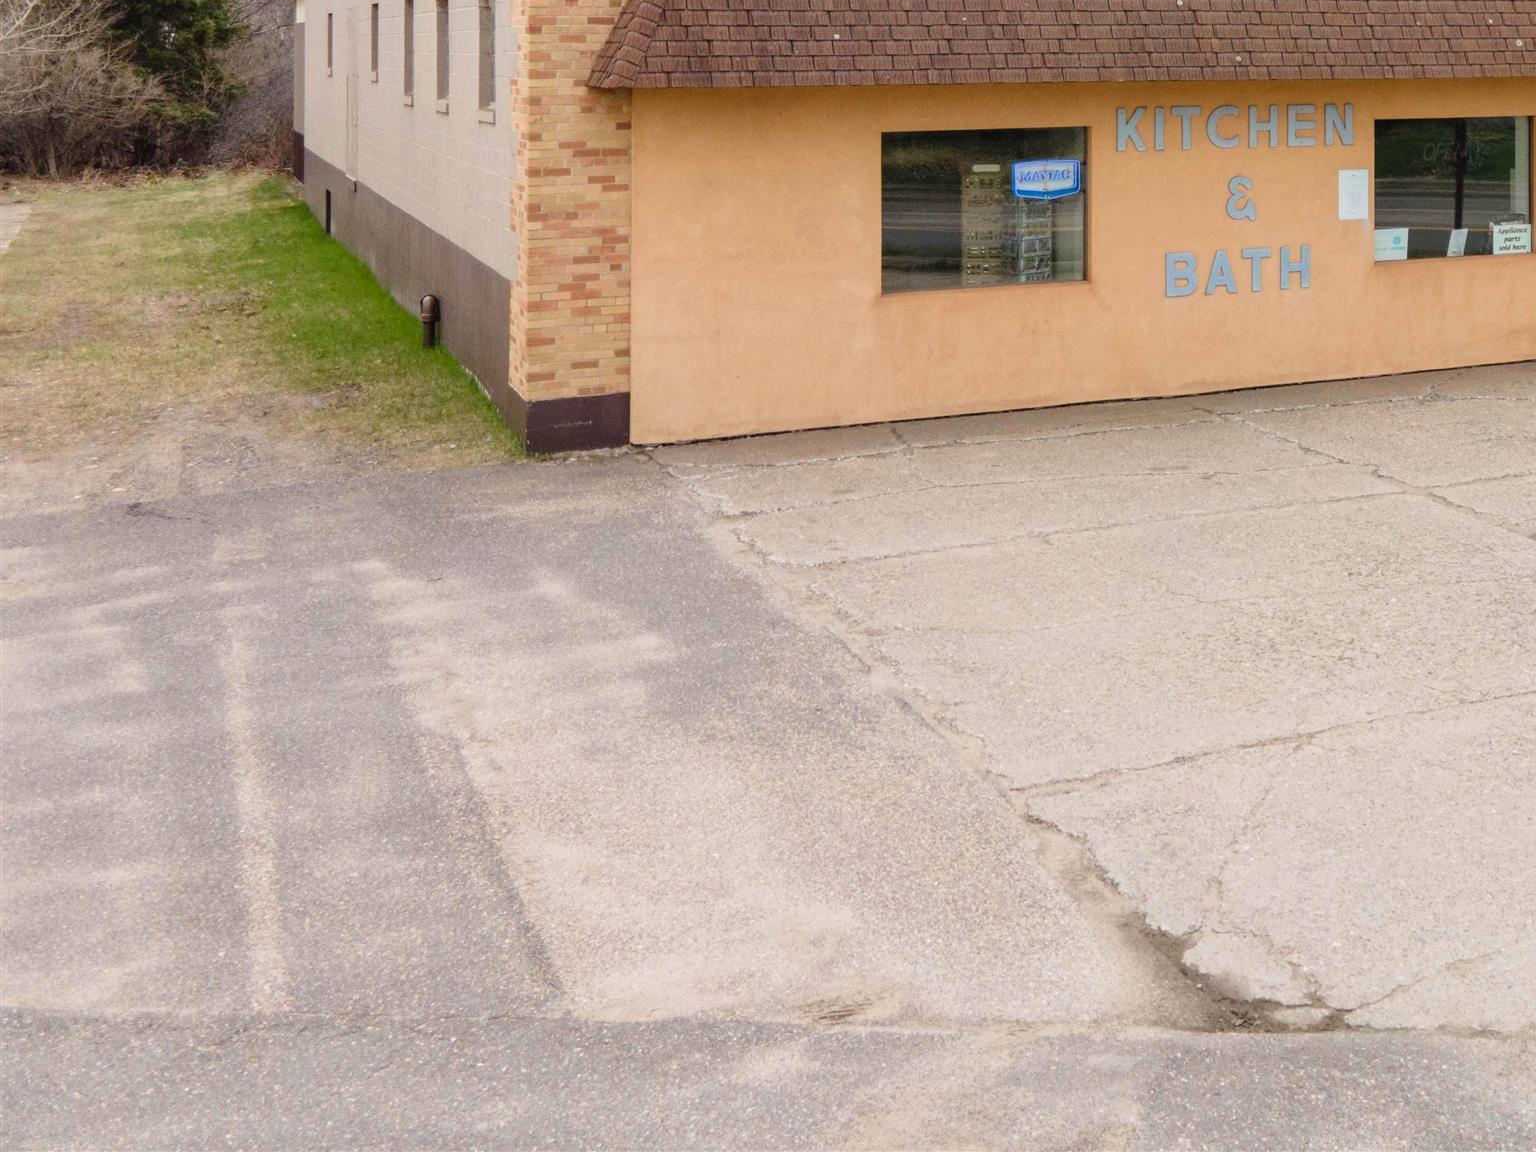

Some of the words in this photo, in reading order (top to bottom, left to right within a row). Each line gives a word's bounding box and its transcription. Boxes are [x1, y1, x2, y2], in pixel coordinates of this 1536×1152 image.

[1115, 102, 1355, 152] KITCHEN
[1019, 168, 1071, 184] MAYTAG
[1225, 175, 1256, 221] &
[1504, 236, 1521, 244] parts
[1164, 244, 1311, 298] BATH
